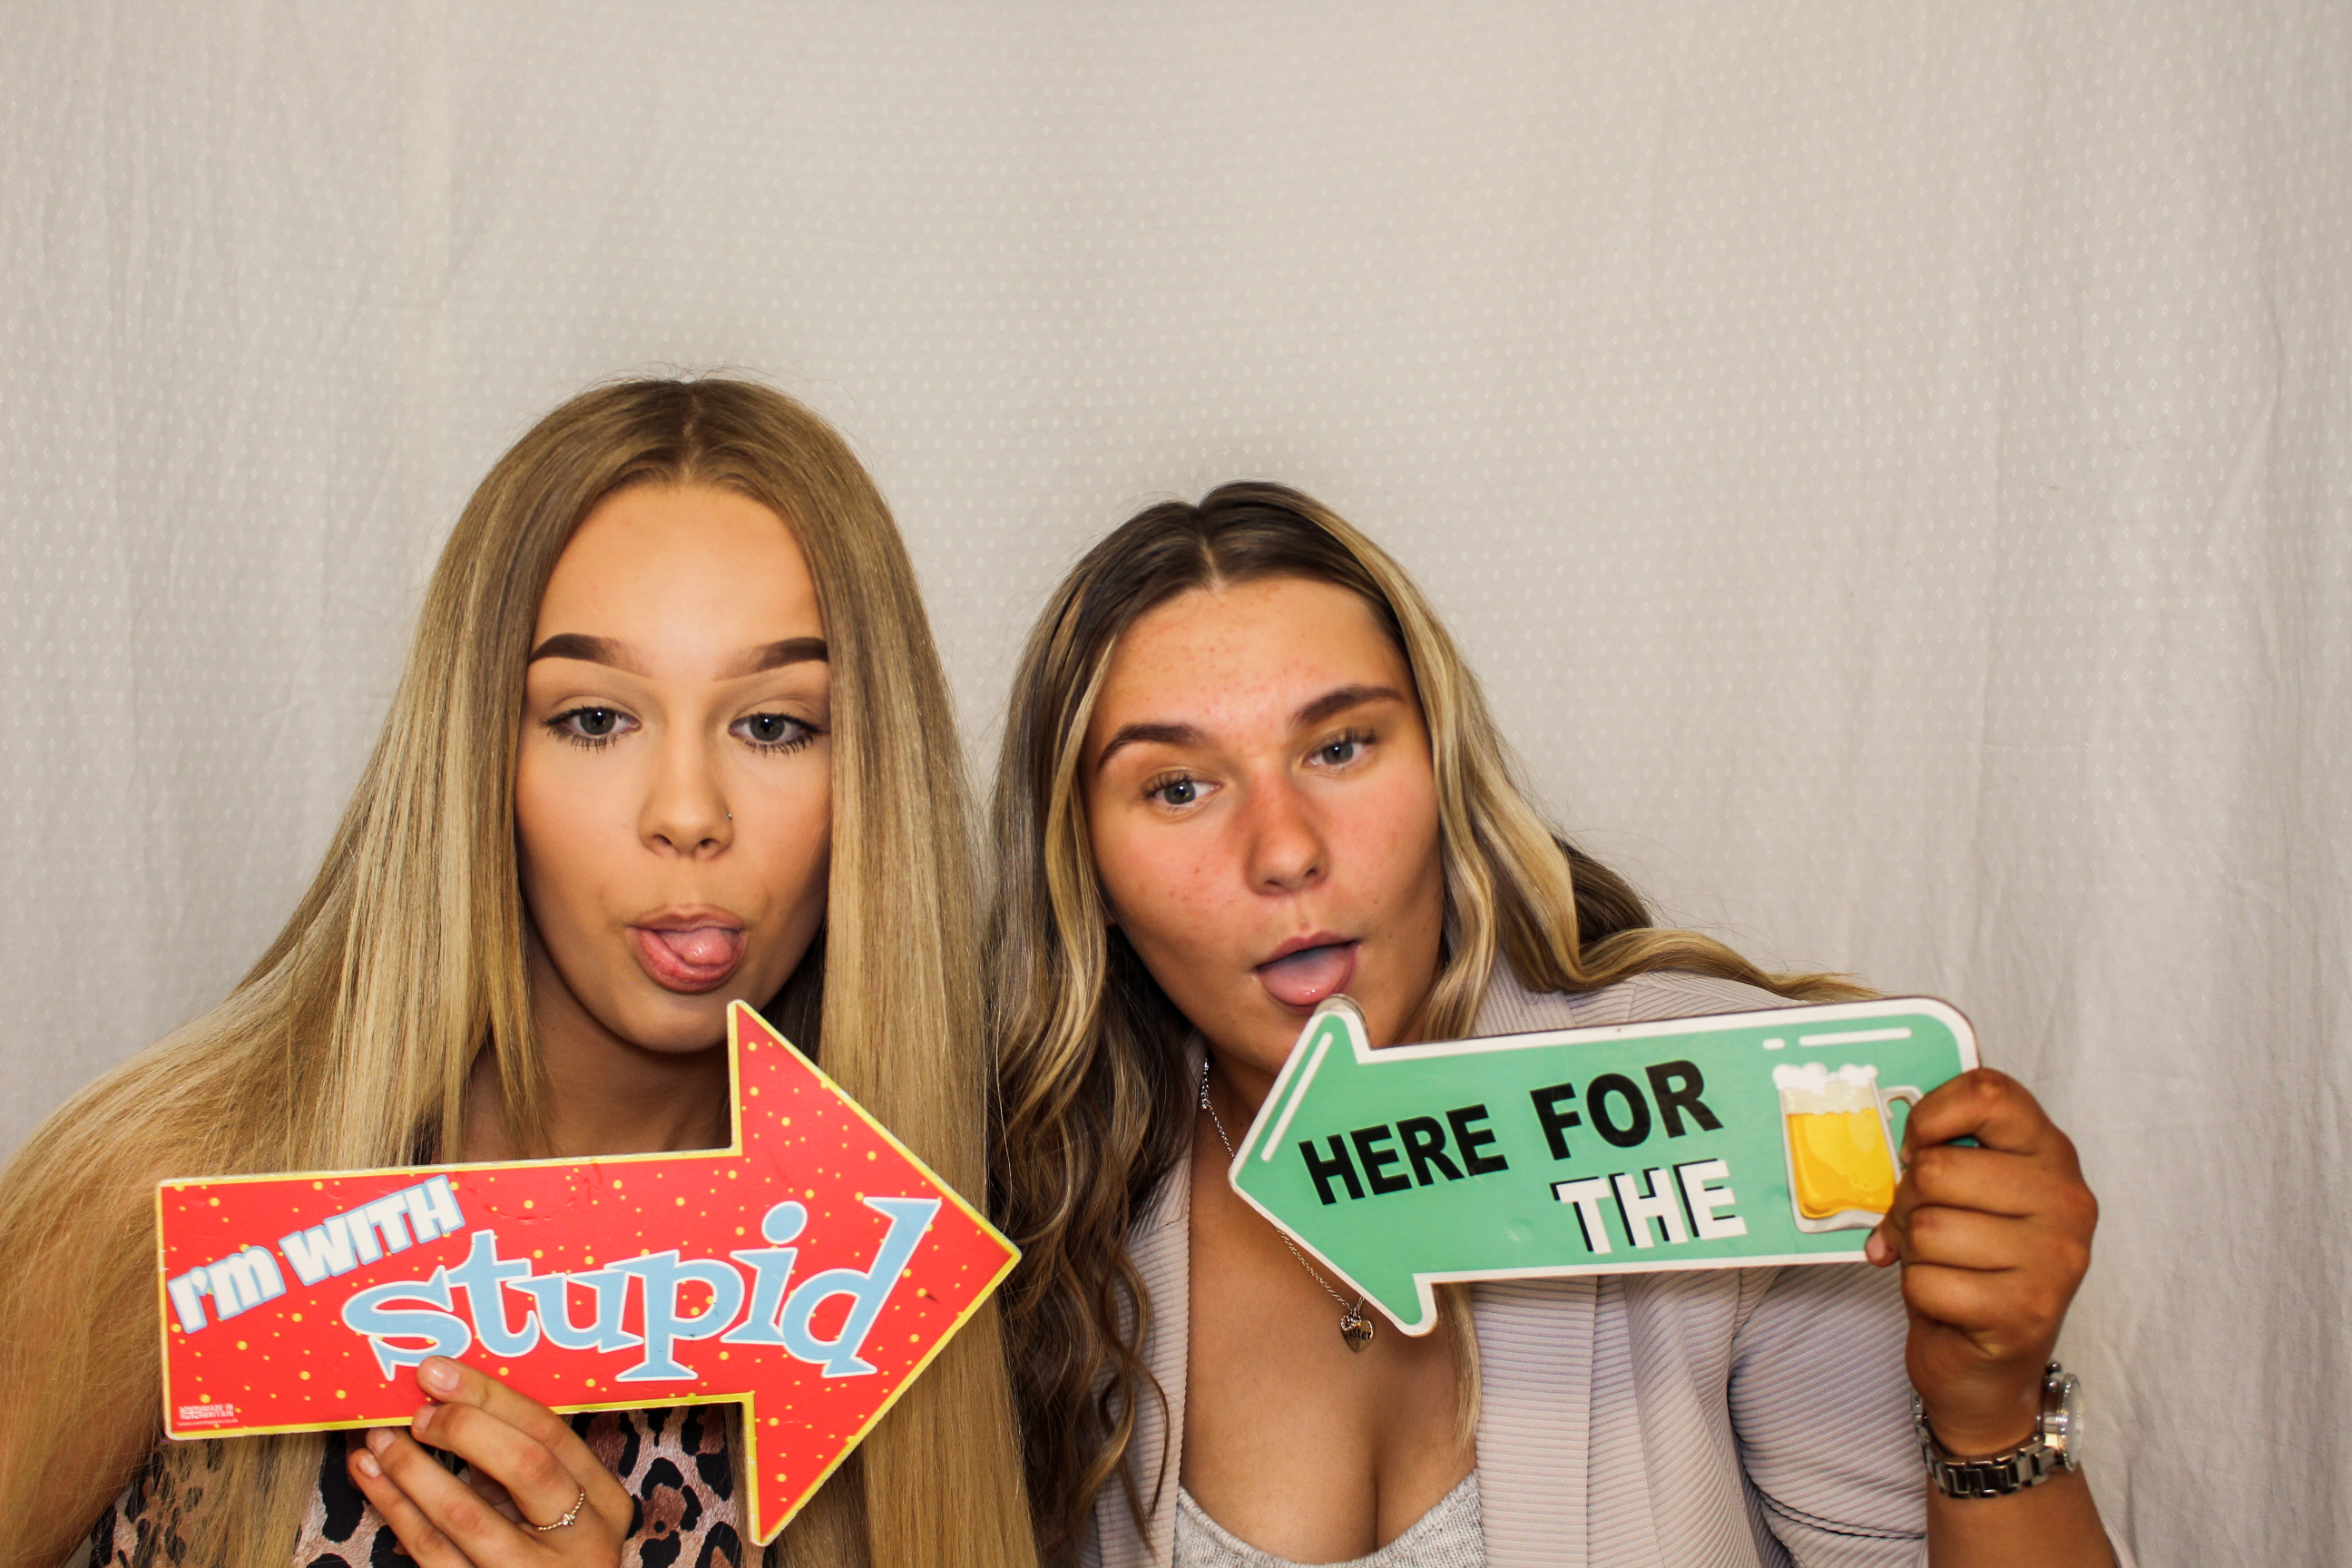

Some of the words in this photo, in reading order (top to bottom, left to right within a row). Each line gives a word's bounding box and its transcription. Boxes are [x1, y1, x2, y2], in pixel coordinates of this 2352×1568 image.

[1298, 1103, 1509, 1205] HERE
[1530, 1060, 1723, 1161] FOR
[279, 1174, 466, 1287] WITH
[1550, 1159, 1747, 1255] THE
[341, 1198, 942, 1381] stupid
[203, 1404, 224, 1412] MADE
